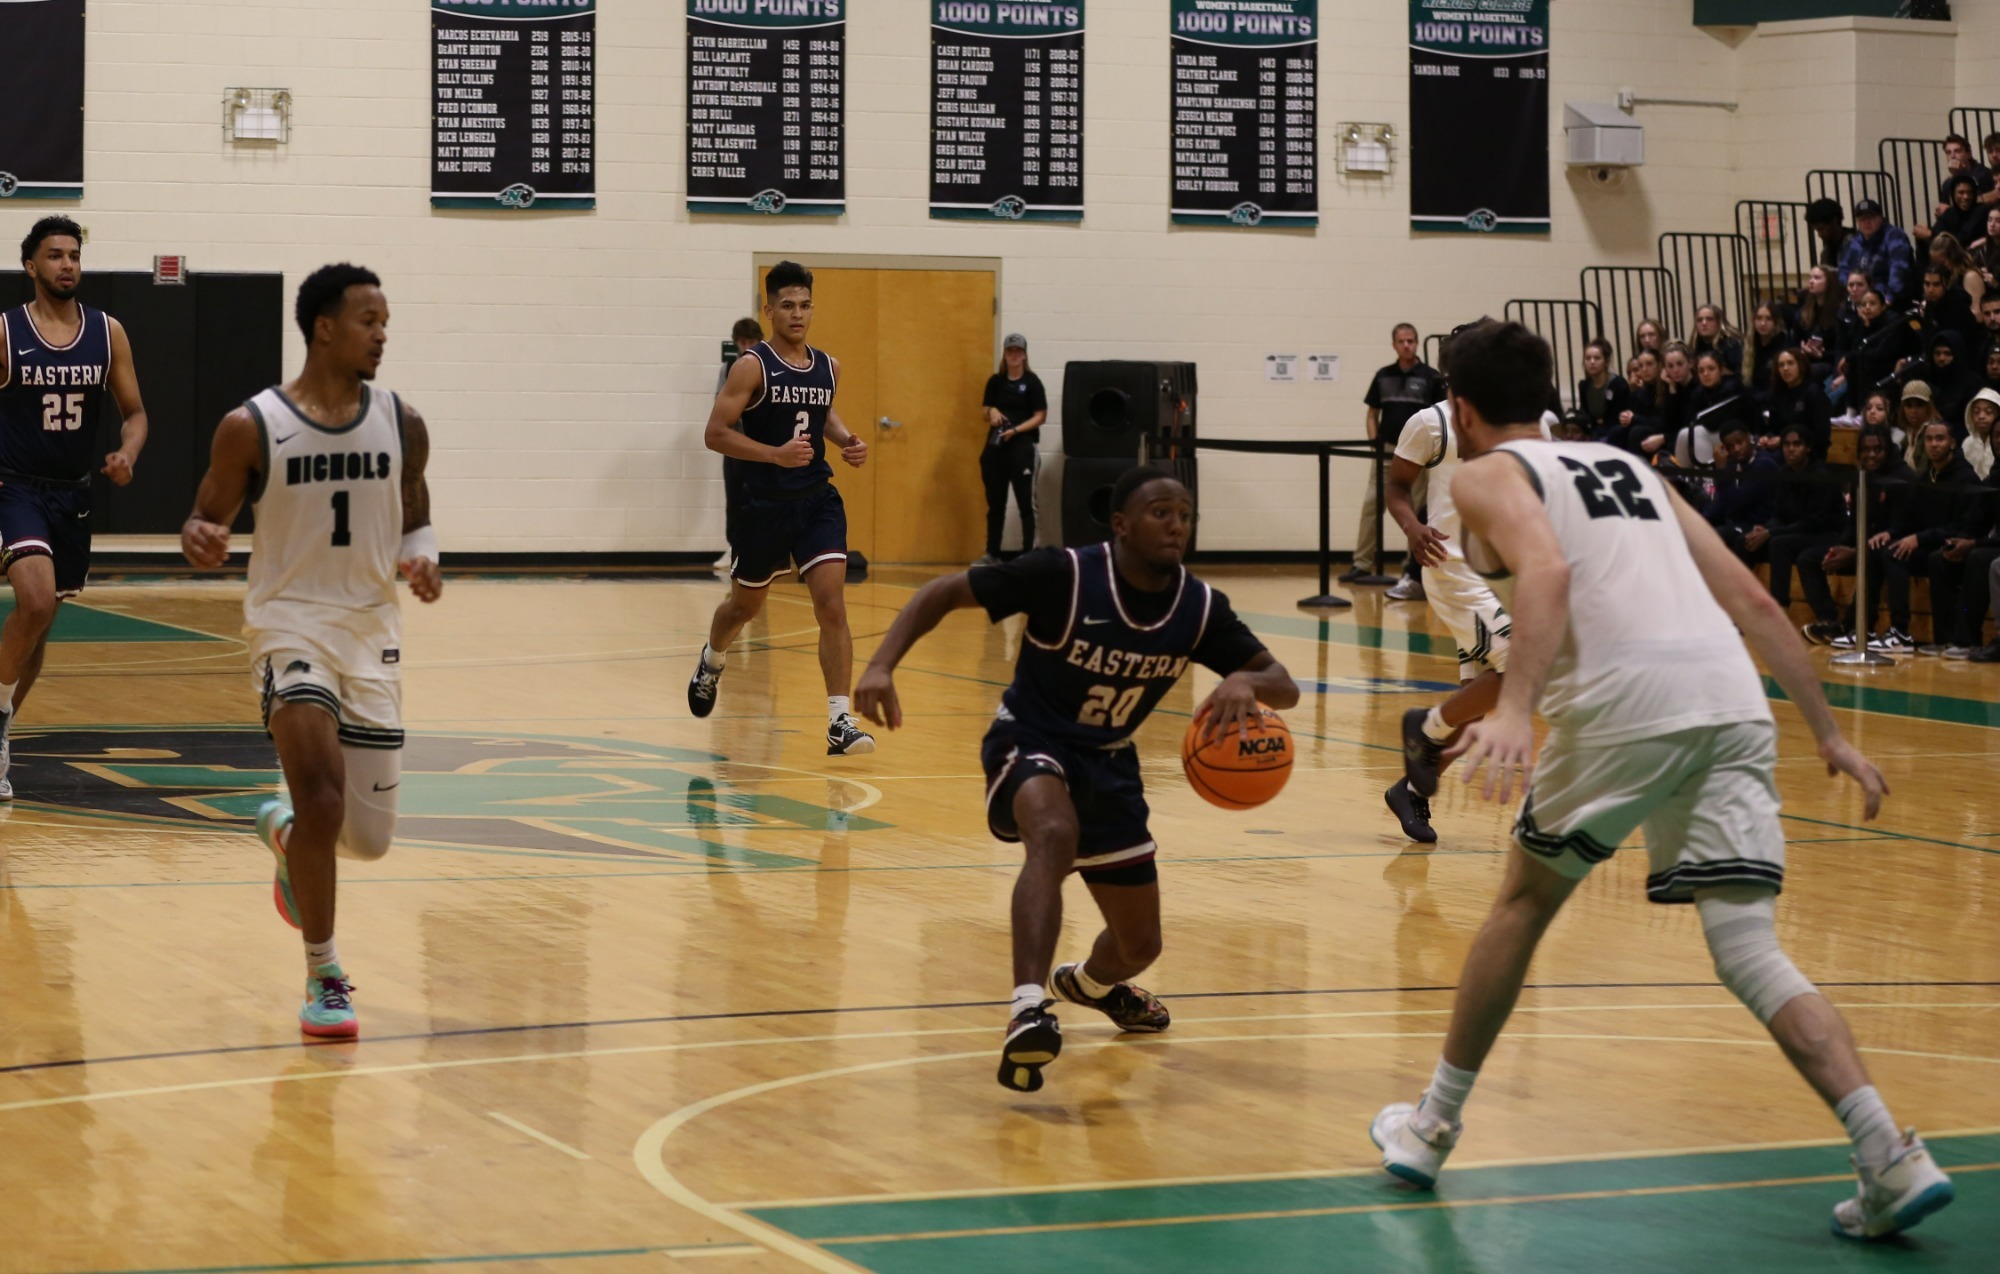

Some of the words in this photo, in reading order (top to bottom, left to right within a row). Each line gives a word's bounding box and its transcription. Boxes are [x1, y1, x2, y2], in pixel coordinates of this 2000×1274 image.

[694, 0, 747, 14] 1000
[754, 0, 839, 17] POINTS
[1196, 1, 1236, 11] WOMEN'S
[1238, 2, 1293, 13] BASKETBALL
[938, 2, 990, 23] 1000
[997, 4, 1078, 27] POINTS
[1432, 11, 1472, 21] WOMEN'S
[1473, 13, 1526, 23] BASKETBALL
[1178, 11, 1227, 33] 1000
[1233, 13, 1312, 36] POINTS
[438, 29, 468, 40] MARCOS
[471, 30, 519, 41] ECHEVARRIA
[1415, 22, 1462, 43] 1000
[1468, 24, 1544, 46] POINTS
[693, 36, 716, 47] KEVIN
[470, 44, 501, 55] BRUTON
[937, 45, 960, 56] CASEY
[962, 46, 990, 57] BUTLER
[693, 51, 710, 62] BILL
[712, 52, 751, 63] LAPLANTE
[438, 58, 459, 69] RYAN
[461, 59, 496, 70] SHEEHAN
[937, 59, 959, 70] BRIAN
[693, 65, 713, 76] GARY
[438, 73, 460, 84] BILLY
[462, 74, 494, 84] COLLINS
[937, 74, 958, 84] CHRIS
[693, 80, 728, 91] ANTHONY
[438, 88, 452, 98] VIN
[455, 88, 482, 99] MILLER
[937, 88, 955, 99] JEFF
[692, 94, 719, 105] IRVING
[721, 95, 762, 106] EGGLESTON
[438, 102, 459, 113] FRED
[937, 102, 958, 112] CHRIS
[692, 109, 707, 119] BOB
[710, 109, 732, 120] RULLI
[438, 117, 459, 128] RYAN
[937, 116, 969, 127] GUSTAVE
[692, 123, 714, 134] MATT
[716, 124, 755, 135] LANGADAS
[438, 132, 457, 142] RICH
[936, 130, 956, 141] RYAN
[958, 131, 985, 142] WILCOX
[692, 137, 712, 148] PAUL
[715, 138, 757, 149] BLASEWITZ
[438, 146, 460, 157] MATT
[463, 147, 495, 158] MORROW
[936, 144, 955, 155] GREG
[957, 145, 984, 156] MEIKLE
[692, 152, 717, 163] STEVE
[719, 152, 739, 163] TATA
[438, 161, 460, 172] MARC
[462, 161, 491, 172] DUPUIS
[936, 158, 956, 169] SEAN
[958, 159, 986, 170] BUTLER
[692, 166, 715, 177] CHRIS
[717, 167, 746, 178] VALLEE
[936, 172, 950, 183] BOB
[952, 173, 980, 184] PAYTON
[21, 365, 102, 386] EASTERN
[771, 385, 832, 406] EASTERN
[42, 393, 84, 431] 25
[794, 411, 811, 439] 2
[286, 452, 391, 486] NICHOLS
[1557, 455, 1661, 521] 22
[331, 490, 351, 547] 1
[1066, 638, 1189, 679] EASTERN
[1077, 684, 1145, 728] 20
[1238, 736, 1286, 757] NCAA
